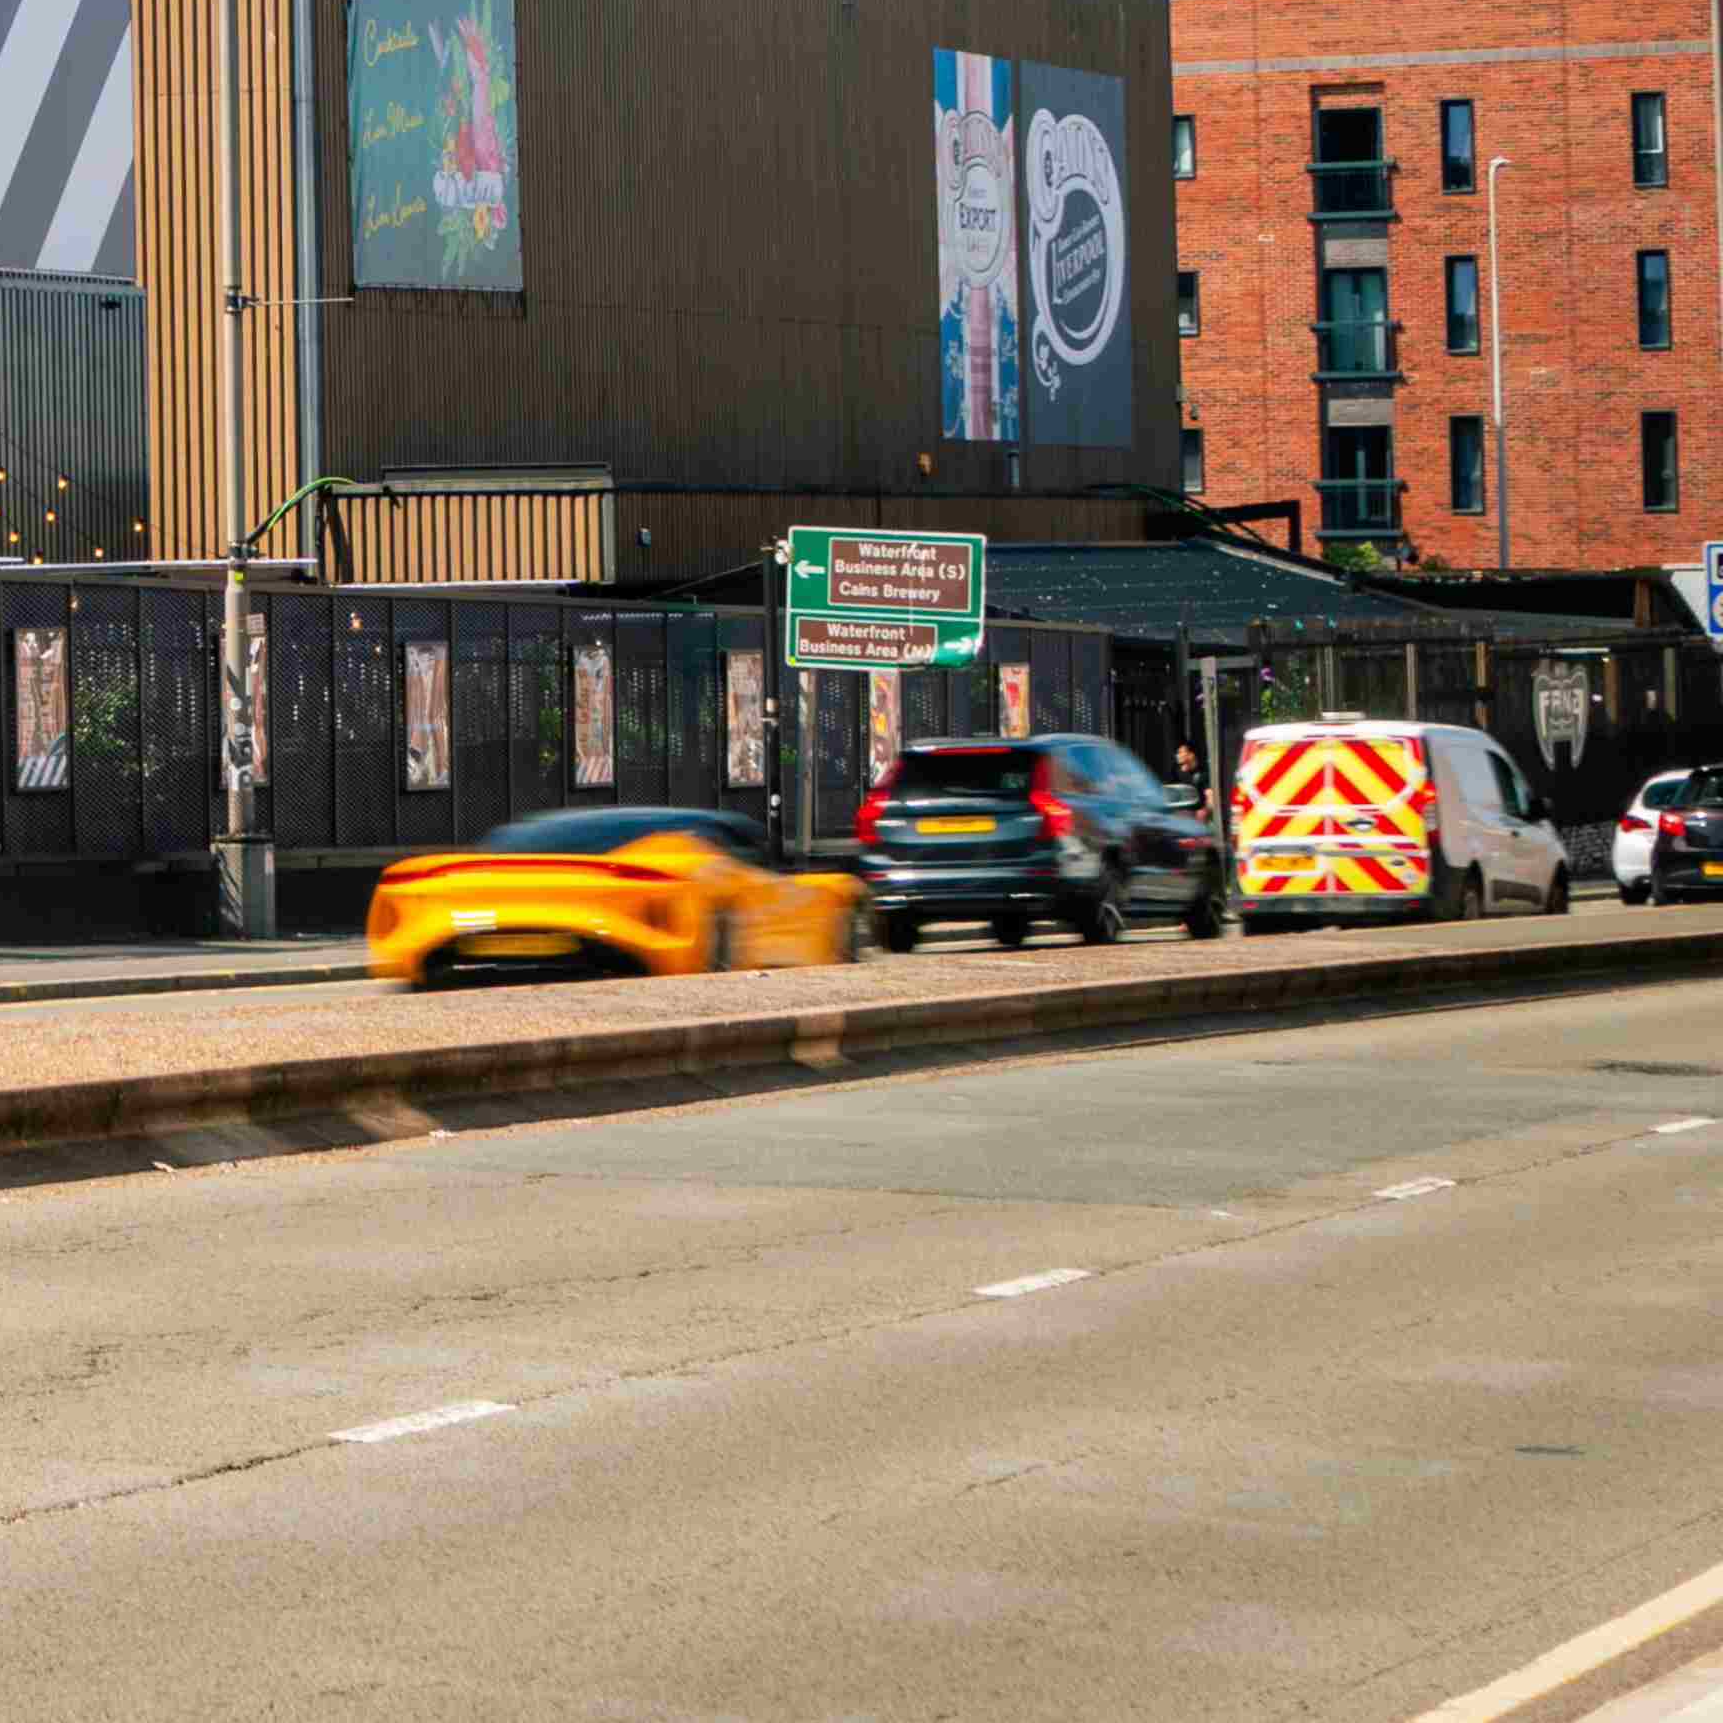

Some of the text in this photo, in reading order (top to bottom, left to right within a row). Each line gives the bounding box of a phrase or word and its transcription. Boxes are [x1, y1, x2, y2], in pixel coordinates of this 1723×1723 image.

[858, 542, 937, 561] Waterfront
[834, 559, 966, 581] Business Area (S)
[838, 581, 941, 603] Cains Brewery
[827, 622, 906, 641] Waterfront
[799, 638, 862, 656] Business
[865, 642, 898, 658] Area
